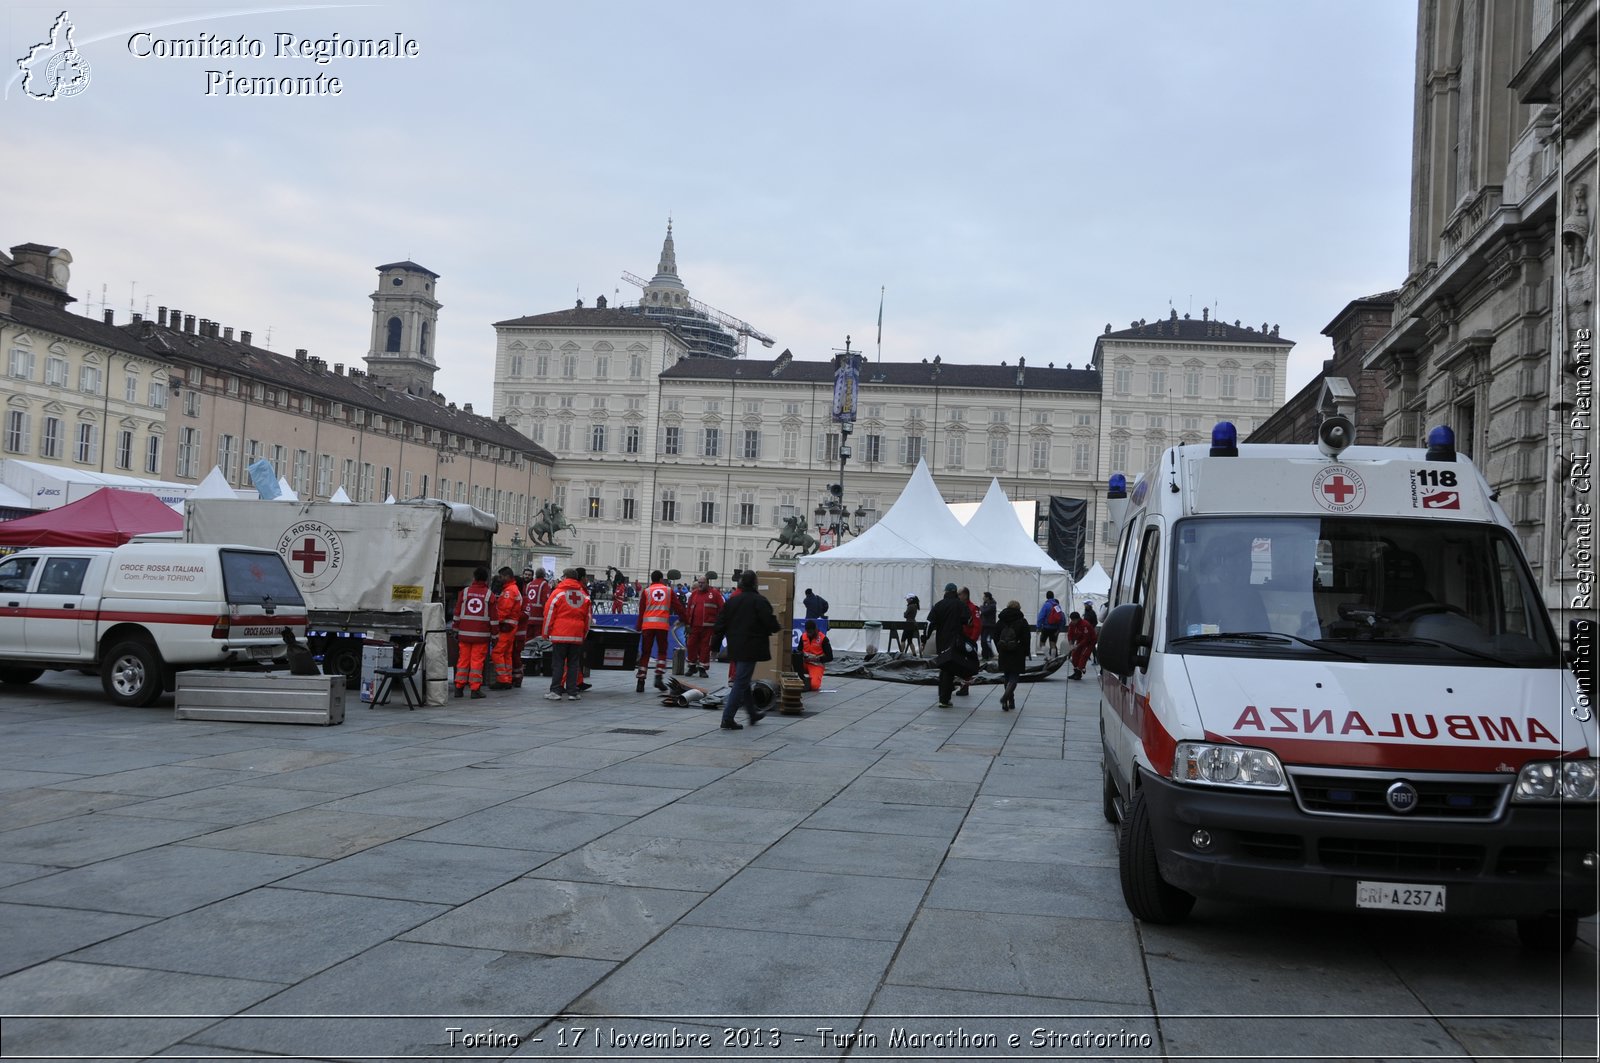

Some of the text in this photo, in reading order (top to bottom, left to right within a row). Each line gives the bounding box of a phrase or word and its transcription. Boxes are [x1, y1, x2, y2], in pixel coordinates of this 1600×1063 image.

[1416, 469, 1458, 487] 118
[45, 488, 61, 496] asics
[1409, 469, 1418, 508] PIEMONTE
[279, 523, 339, 569] OCE ROSSA ITALIANA
[120, 564, 204, 574] CROCE ROSSA ITALIANA
[124, 573, 140, 581] Com.
[166, 574, 195, 583] TORINO
[244, 627, 258, 636] CROCE
[259, 627, 274, 636] ROSSA
[1392, 792, 1412, 803] FIAT
